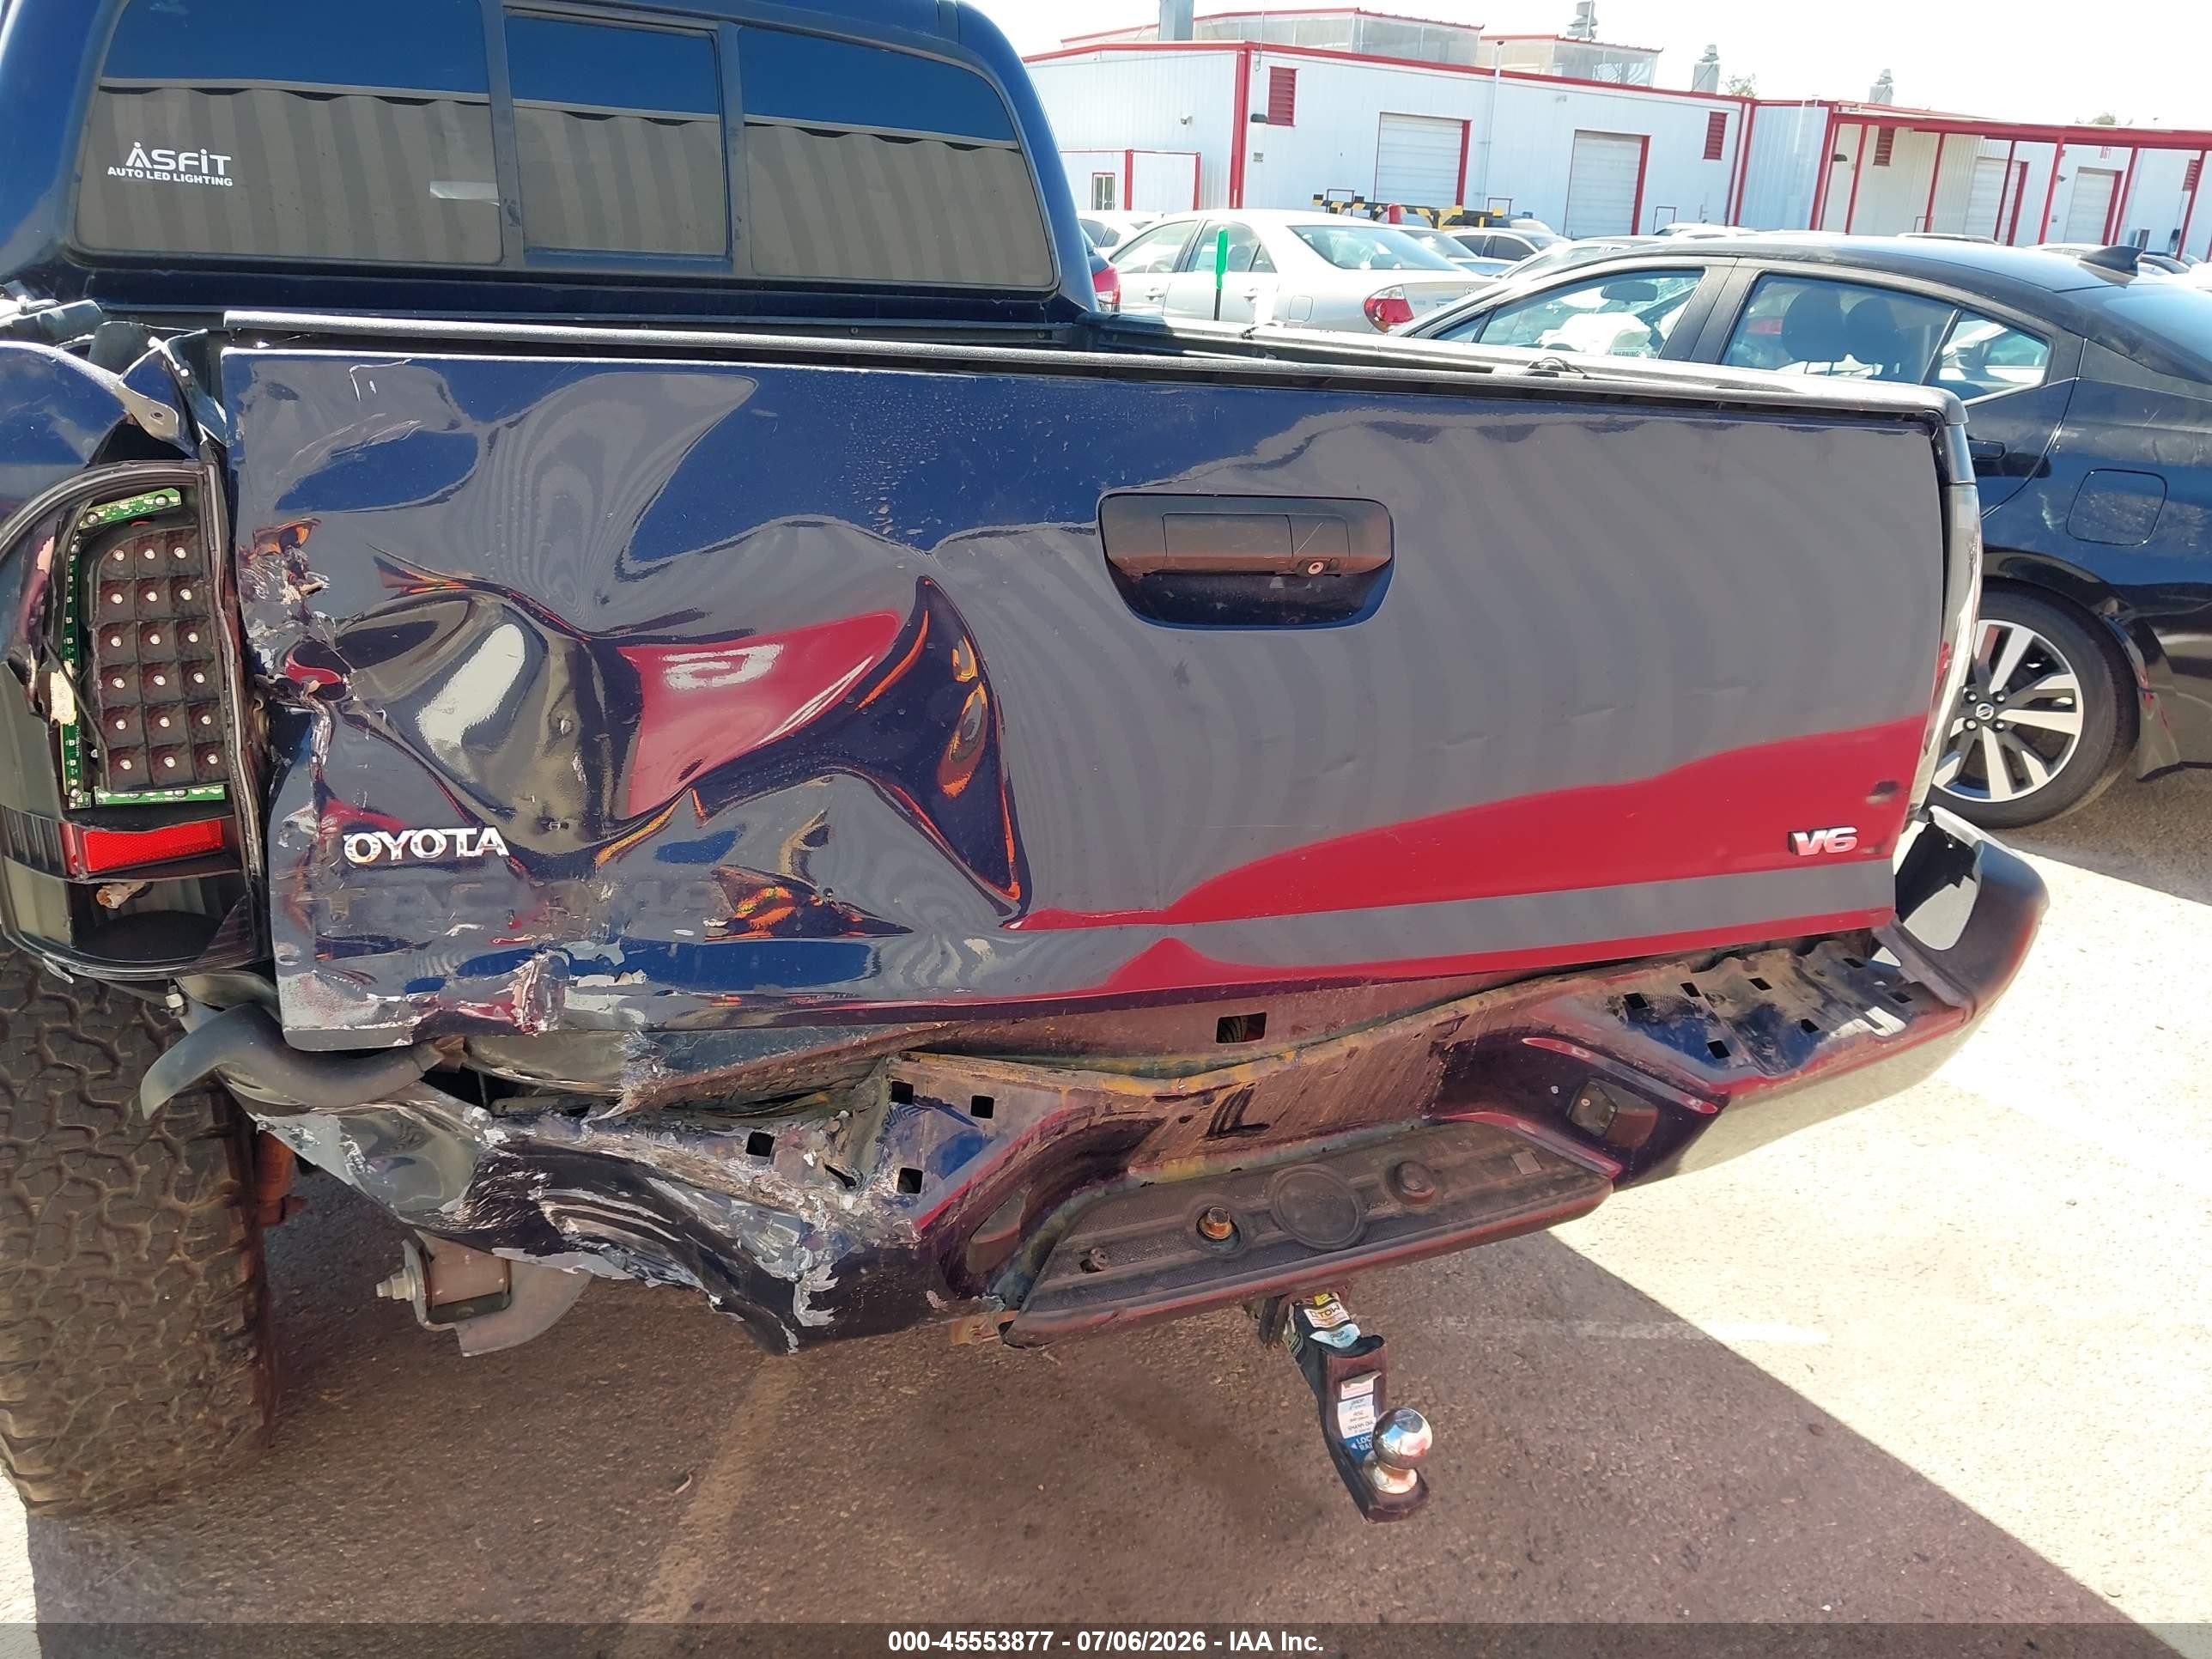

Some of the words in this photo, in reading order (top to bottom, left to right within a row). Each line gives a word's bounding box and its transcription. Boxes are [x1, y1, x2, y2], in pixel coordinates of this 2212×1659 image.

[107, 167, 143, 179] AUTO
[147, 171, 171, 181] LED
[173, 173, 234, 186] LIGHTING
[343, 826, 510, 865] OYOTA
[1787, 825, 1858, 856] V6
